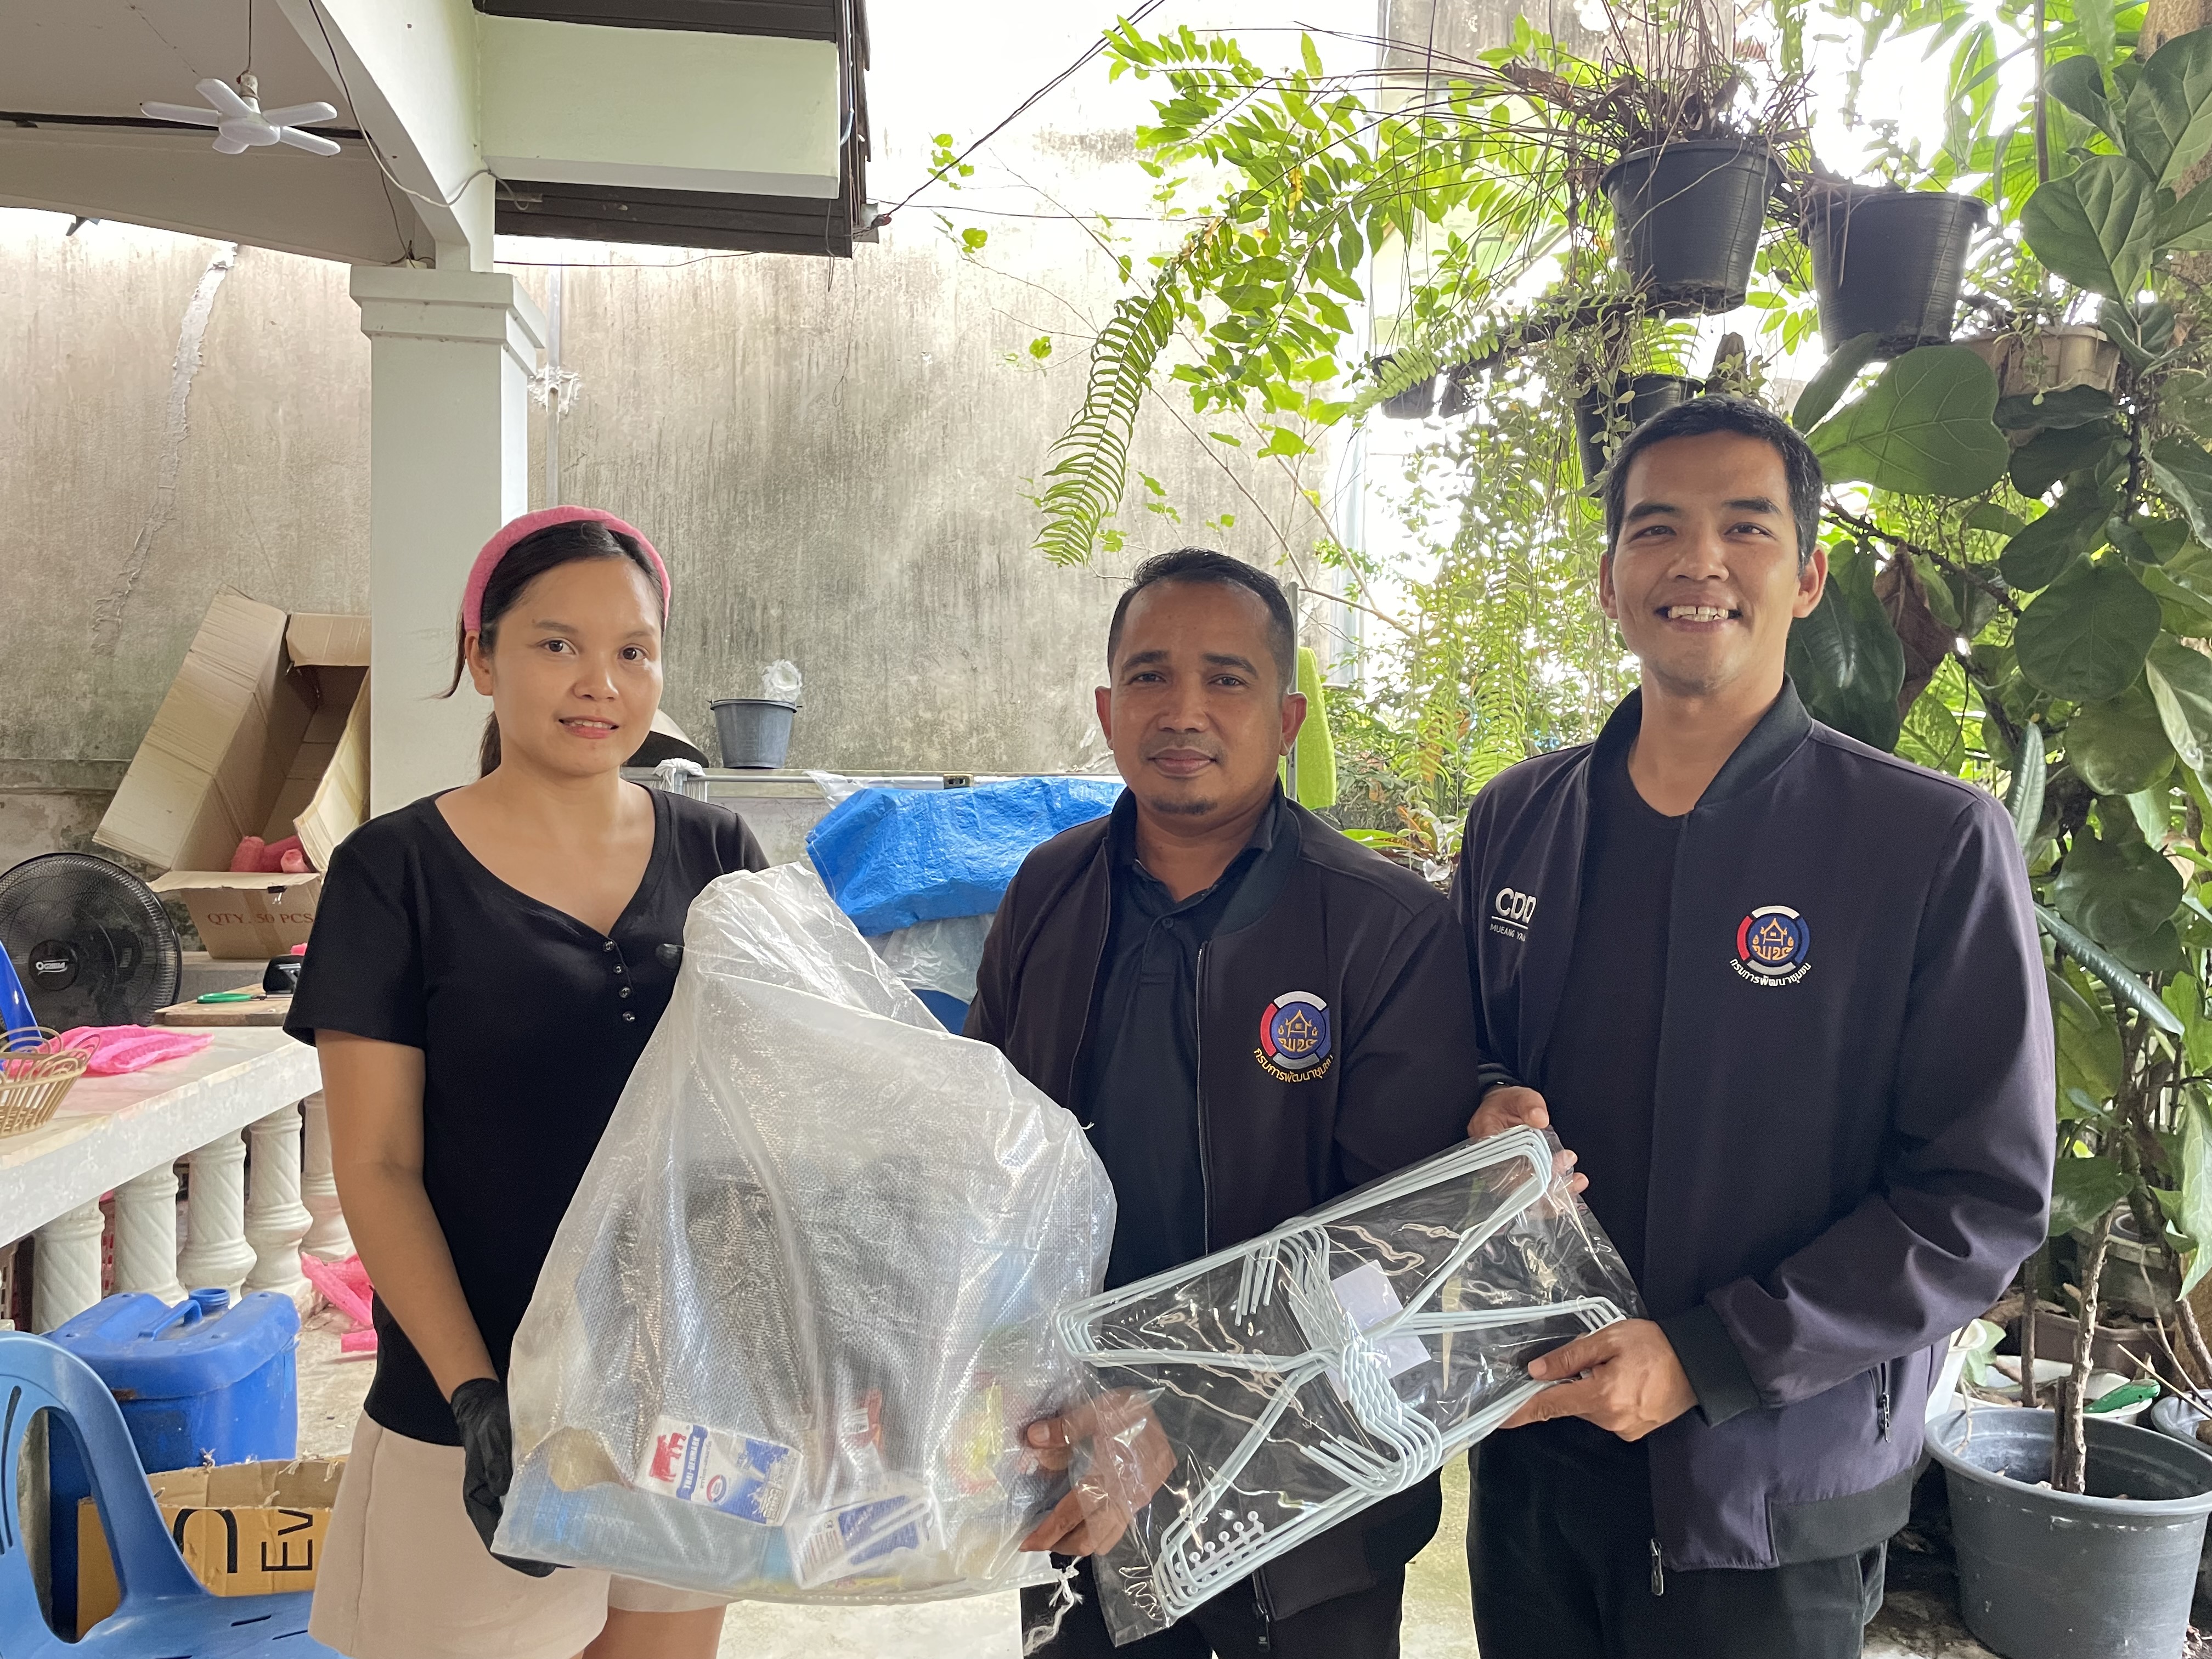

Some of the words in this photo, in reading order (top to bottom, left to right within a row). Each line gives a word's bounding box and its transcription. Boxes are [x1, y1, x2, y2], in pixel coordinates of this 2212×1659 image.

[256, 913, 275, 923] 50
[1496, 888, 1536, 924] CDD
[1490, 923, 1515, 938] MUEANG
[1730, 958, 1812, 986] กรมการพัฒนาชุมชน
[683, 1436, 701, 1490] THAI-DENMARK
